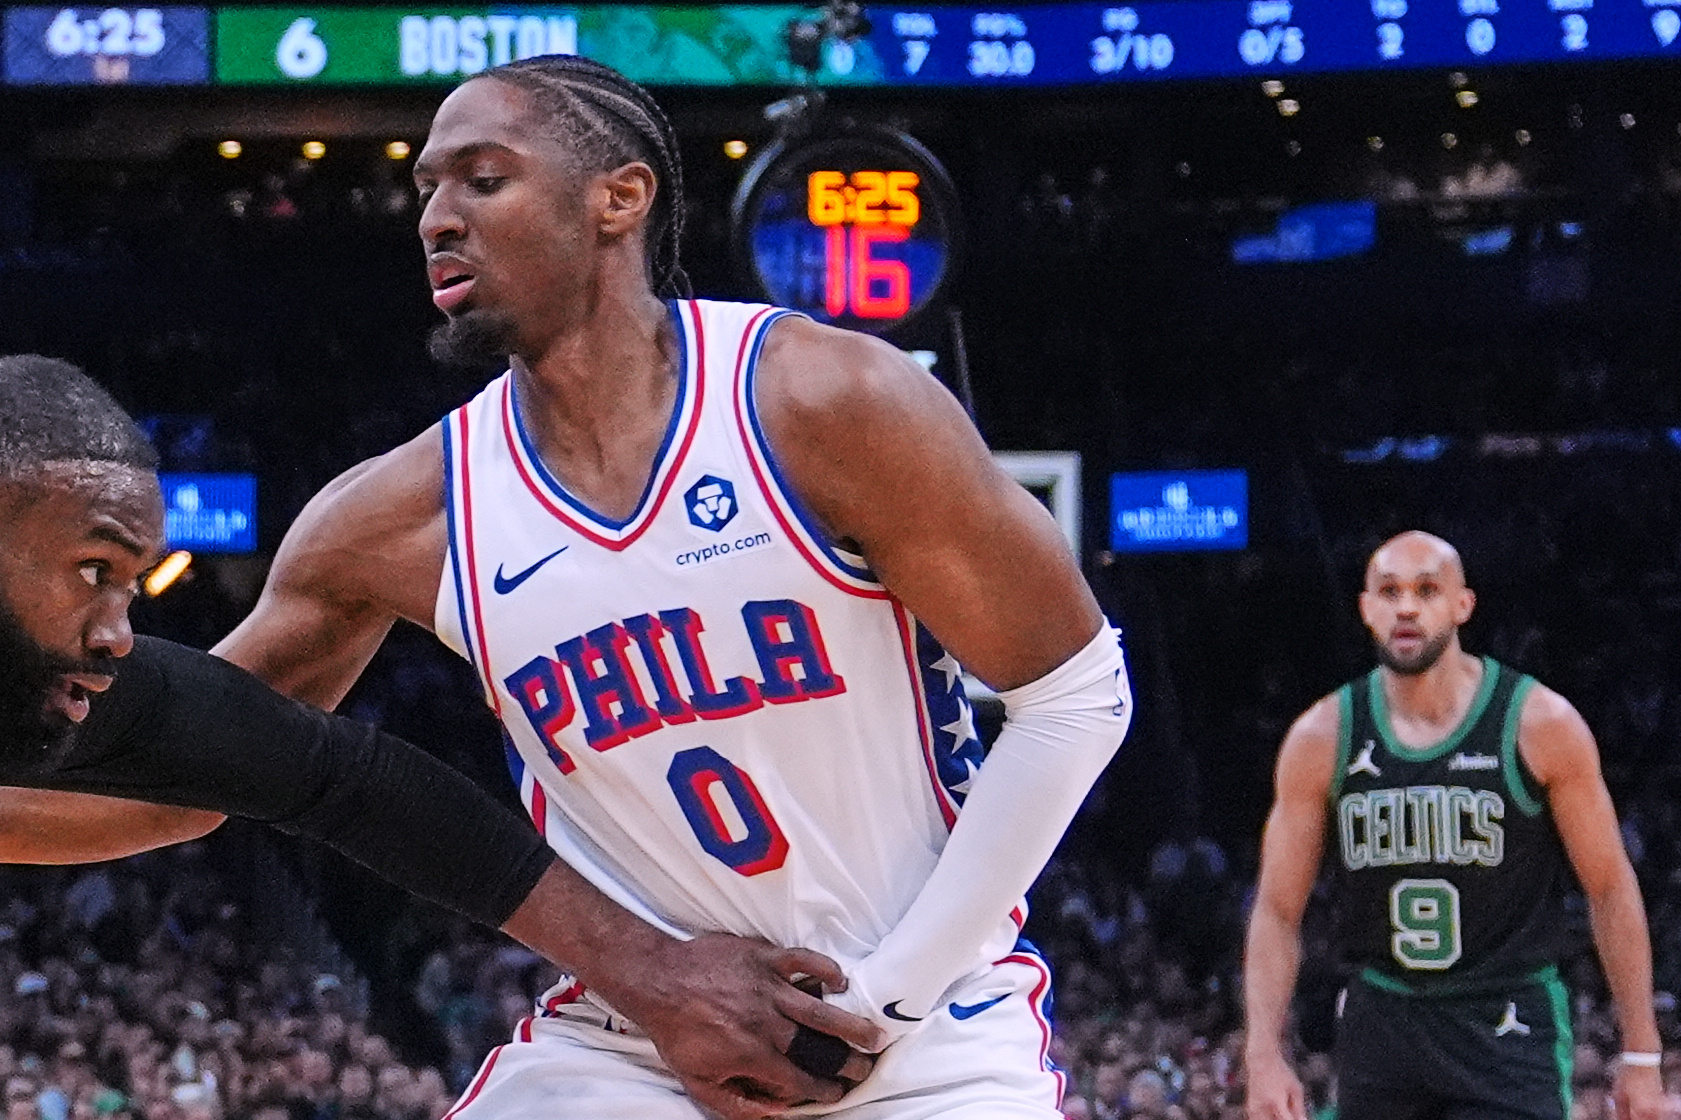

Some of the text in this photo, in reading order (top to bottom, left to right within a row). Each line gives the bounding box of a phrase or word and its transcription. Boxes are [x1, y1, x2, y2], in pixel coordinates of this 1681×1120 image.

[45, 9, 166, 55] 6:25
[276, 18, 328, 78] 6
[399, 15, 578, 75] BOSTON
[1465, 19, 1496, 55] 0
[808, 170, 921, 227] 6:25
[825, 226, 910, 319] 16
[676, 530, 772, 566] crypto.com
[504, 599, 846, 776] PHILA
[666, 746, 790, 877] 0
[1339, 785, 1505, 871] CELTICS
[1389, 878, 1461, 970] 9
